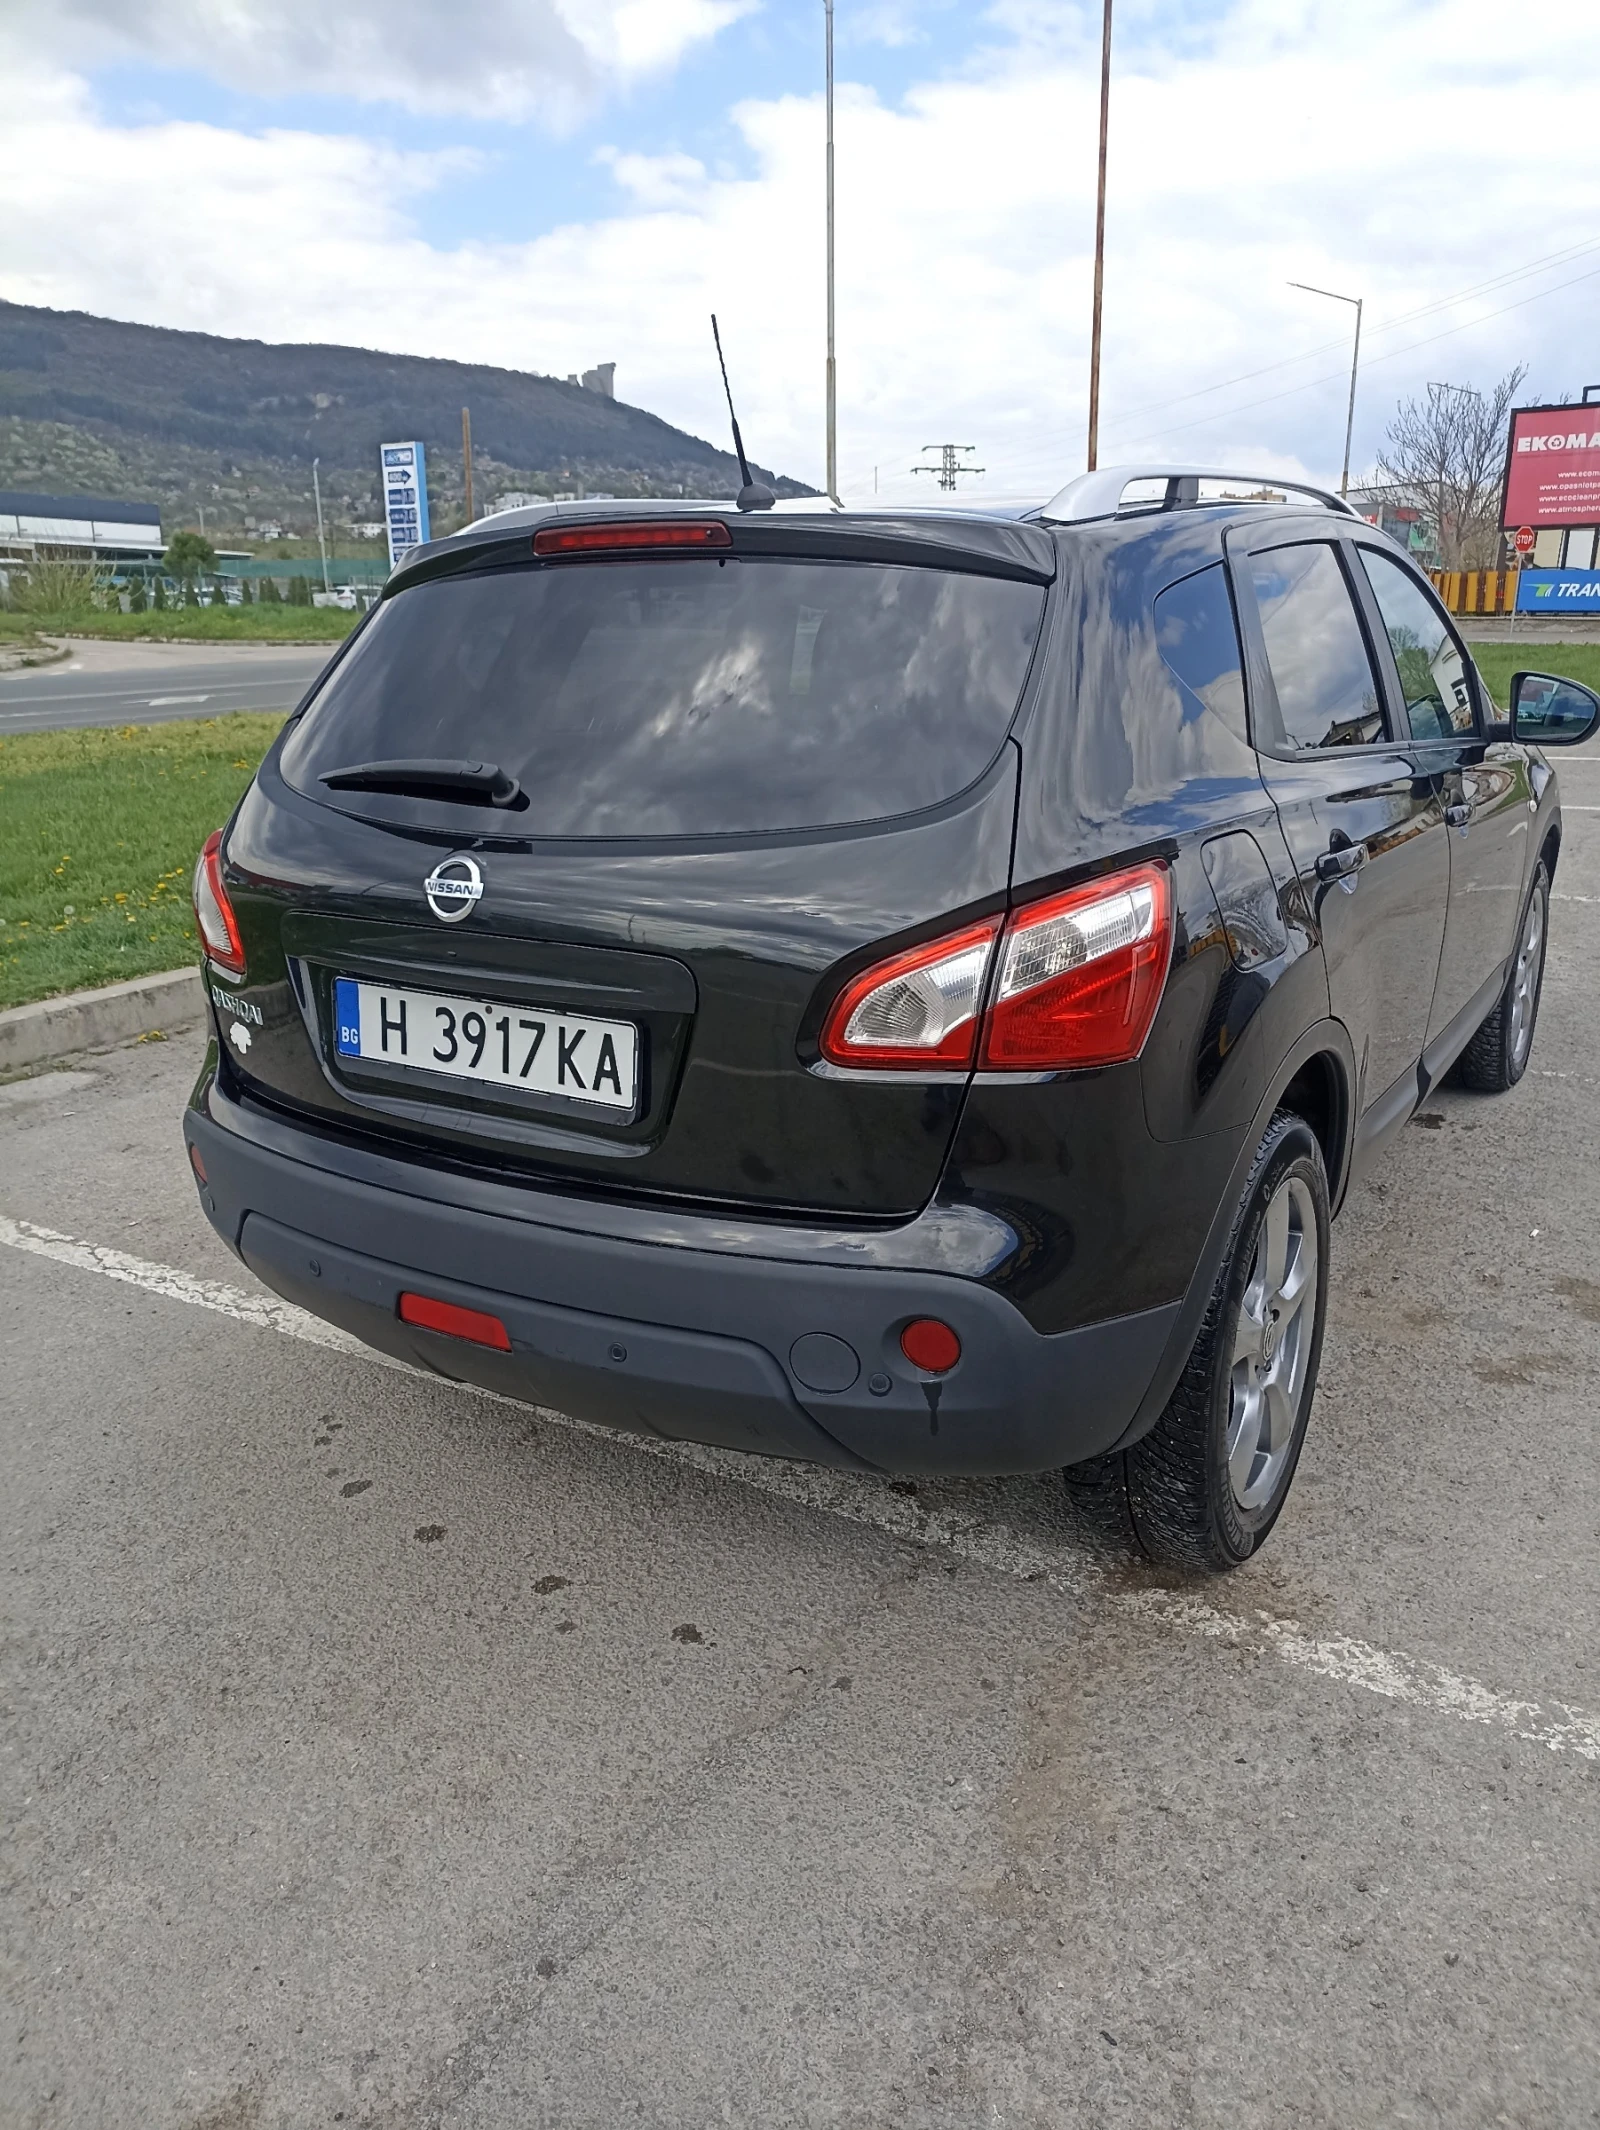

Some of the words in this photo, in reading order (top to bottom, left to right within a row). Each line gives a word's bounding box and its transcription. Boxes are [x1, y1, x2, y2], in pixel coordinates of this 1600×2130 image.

[1538, 505, 1600, 514] www.atmospher
[1516, 534, 1533, 545] STOP
[427, 881, 474, 896] NISSAN
[380, 996, 407, 1056] H
[341, 1026, 359, 1045] BG
